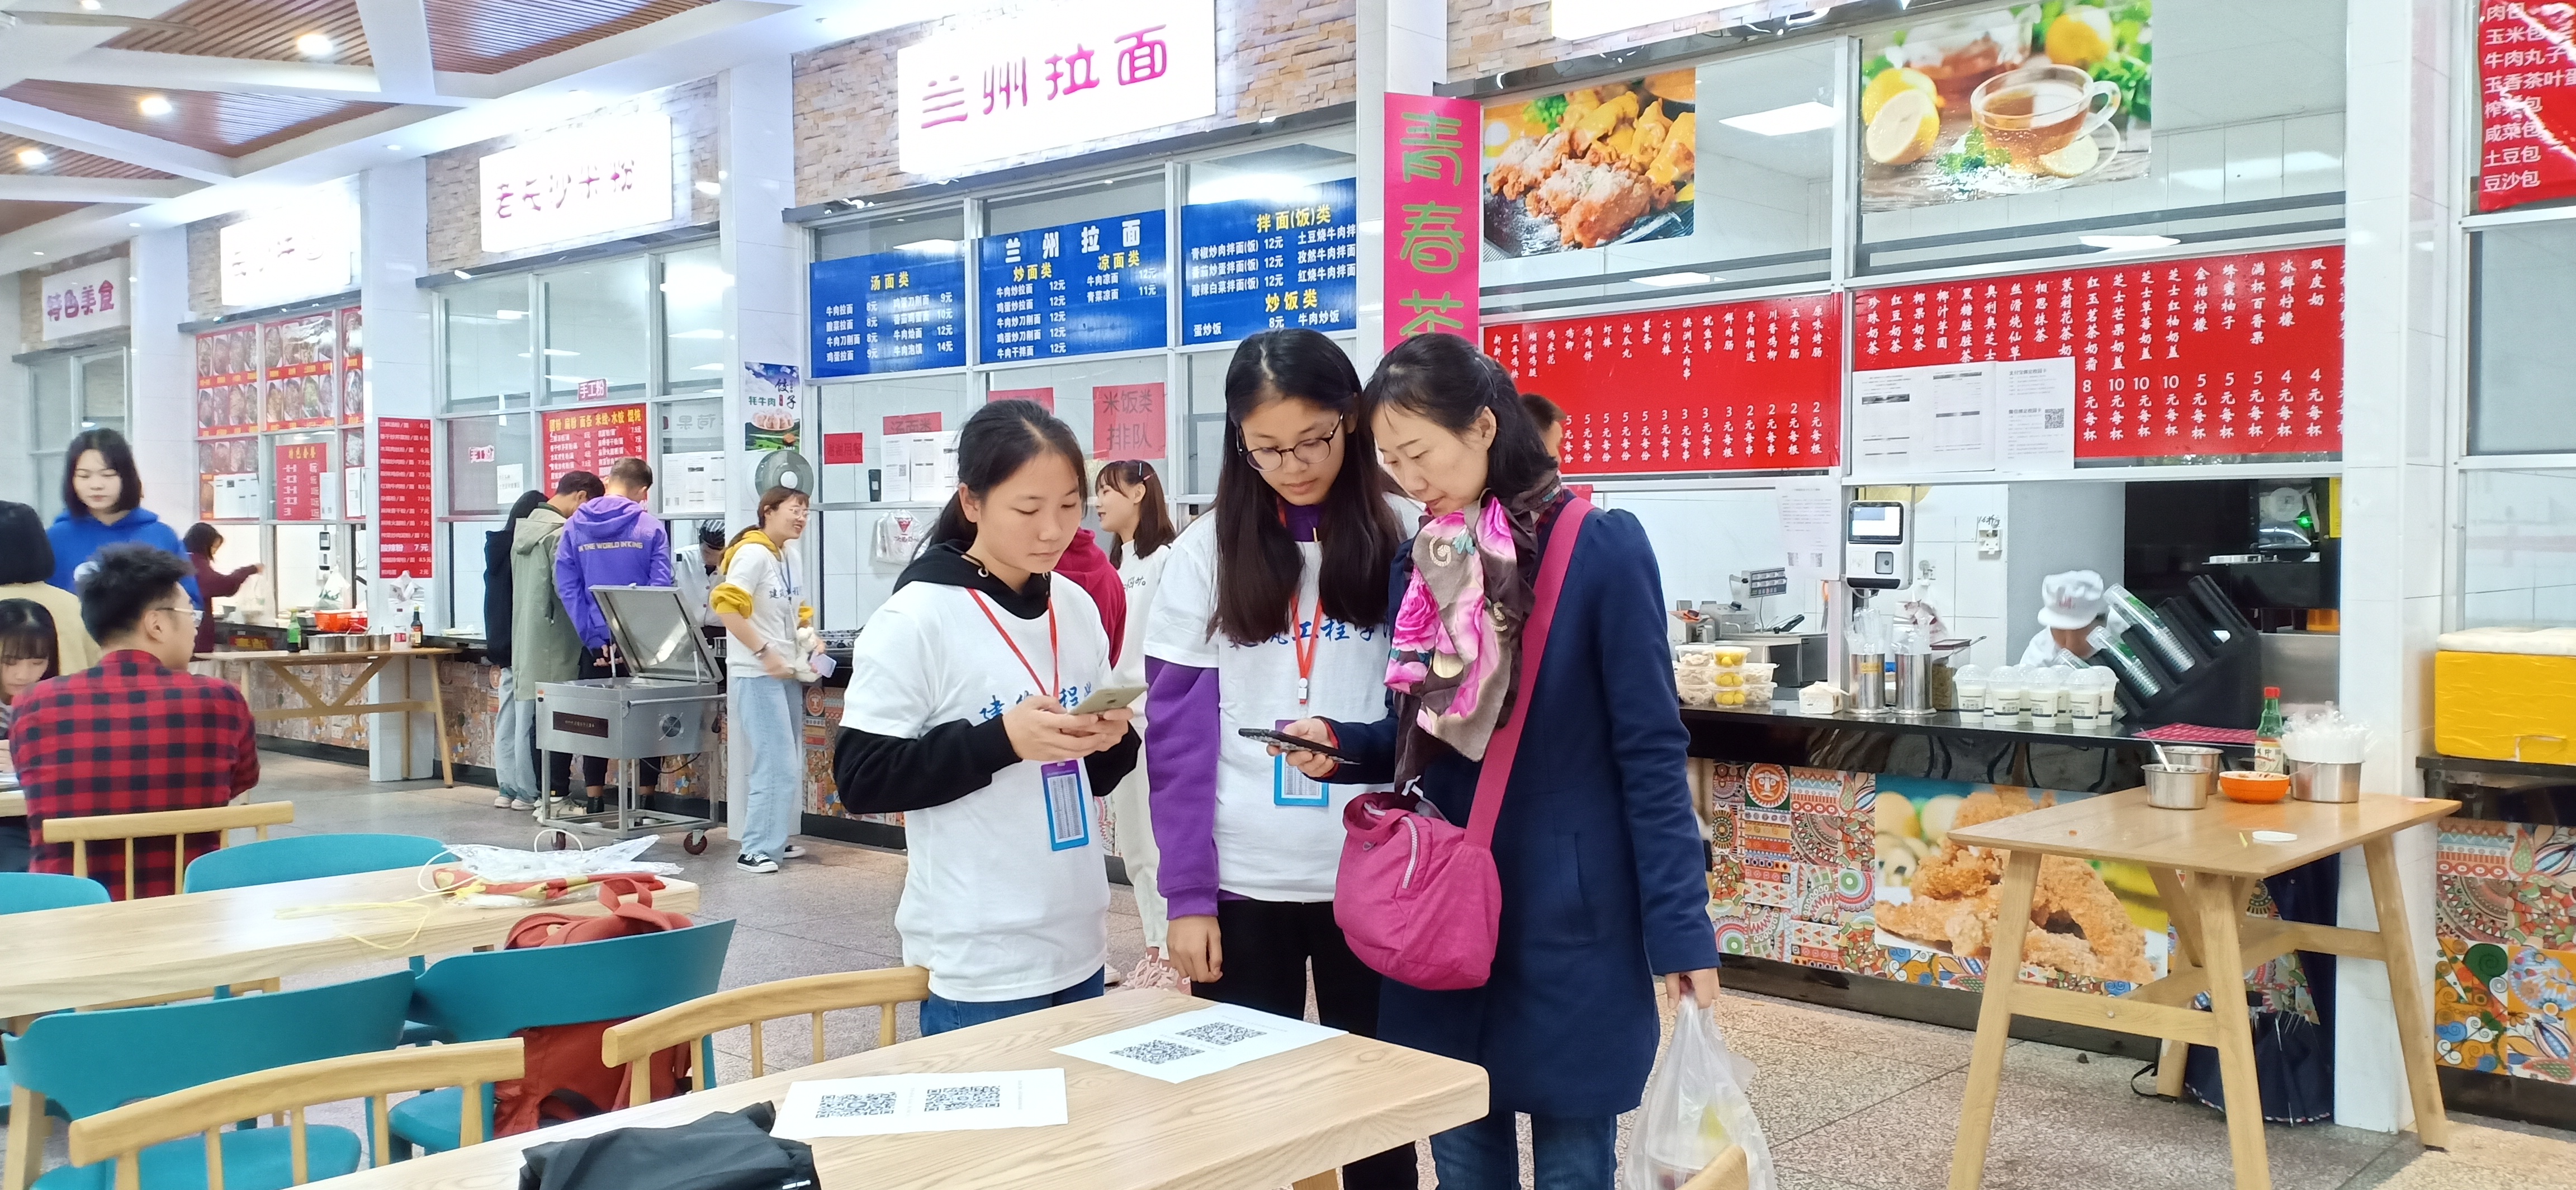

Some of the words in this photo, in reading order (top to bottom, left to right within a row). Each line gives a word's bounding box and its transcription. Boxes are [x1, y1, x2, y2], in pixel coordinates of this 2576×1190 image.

[2485, 26, 2545, 45] 玉米包
[2484, 46, 2566, 69] 牛肉丸子
[921, 24, 1166, 129] 兰州拉面
[2484, 145, 2542, 168] 土豆包
[2483, 170, 2542, 192] 豆沙包
[1005, 219, 1141, 263] 兰州拉面
[1399, 110, 1465, 337] 青春茶
[1013, 262, 1052, 282] 炒面类
[1098, 249, 1140, 271] 凉面类
[1191, 239, 1259, 261] 青椒炒肉拌面(饭)
[1264, 236, 1284, 249] 12元
[1264, 255, 1284, 268] 12元
[870, 271, 909, 291] 汤面类
[996, 284, 1033, 298] 牛肉炒拉面
[1049, 280, 1066, 291] 12元
[1087, 272, 1119, 287] 牛肉凉面
[1139, 268, 1157, 280] 12元
[1265, 273, 1284, 287] 12元
[1298, 263, 1356, 283] 红烧牛肉拌面
[2278, 259, 2296, 327] 冰鲜柠檬
[2308, 258, 2327, 306] 双皮奶
[48, 280, 114, 322] 特色美食
[826, 304, 853, 317] 牛肉拉面
[866, 301, 878, 312] 8元
[940, 292, 953, 303] 9元
[996, 299, 1033, 314] 鸡蛋炒拉面
[1049, 295, 1066, 306] 12元
[1087, 289, 1119, 303] 青菜凉面
[1139, 285, 1157, 296] 11元
[1265, 288, 1318, 313] 炒饭类
[2034, 280, 2049, 343] 相思抹茶
[2166, 268, 2182, 360] 芝士红柚奶盖
[2192, 267, 2210, 332] 金桔柠檬
[2221, 264, 2238, 330] 蜂蜜柚子
[2250, 261, 2266, 344] 满杯百香果
[866, 317, 878, 328] 8元
[937, 309, 953, 319] 10元
[996, 314, 1041, 329] 牛肉炒刀削面
[1050, 311, 1066, 322] 12元
[1194, 322, 1221, 337] 蛋炒饭
[1269, 316, 1285, 329] 8元
[1298, 309, 1339, 327] 牛肉炒饭
[1642, 318, 1652, 344] 薯条
[1723, 311, 1734, 351] 鲜肉肠
[1811, 305, 1824, 358] 原味烤肠
[1866, 296, 1880, 355] 珍珠奶茶
[1889, 294, 1903, 353] 红豆奶茶
[1912, 291, 1926, 352] 椰果奶茶
[1936, 289, 1949, 349] 椰汁芋圆
[1984, 284, 1998, 360] 奥利奥芝士
[2083, 276, 2100, 371] 红玉茗茶奶霜
[2110, 272, 2127, 371] 芝士芒果奶盖
[2138, 270, 2154, 361] 芝士草莓奶盖
[826, 334, 860, 348] 牛肉刀削面
[866, 332, 878, 343] 8元
[937, 324, 953, 336] 12元
[826, 350, 854, 362] 鸡蛋拉面
[867, 348, 878, 359] 9元
[937, 341, 953, 352] 14元
[997, 329, 1041, 344] 鸡蛋炒刀削面
[1050, 327, 1066, 338] 12元
[1050, 342, 1067, 353] 12元
[1547, 329, 1556, 365] 鸡米花
[1565, 327, 1574, 351] 鸡柳
[1622, 323, 1632, 358] 地瓜丸
[1661, 319, 1671, 356] 七彩棒
[1682, 316, 1693, 381] 澳洲大肉串
[1702, 315, 1713, 353] 鱿鱼串
[1745, 310, 1756, 363] 骨肉相连
[1767, 309, 1778, 361] 川香鸡柳
[1788, 308, 1801, 360] 玉米烤肠
[580, 380, 604, 399] 手工粉
[1103, 388, 1153, 415] 米饭类
[1106, 421, 1153, 451] 排队
[414, 544, 429, 552] 7元
